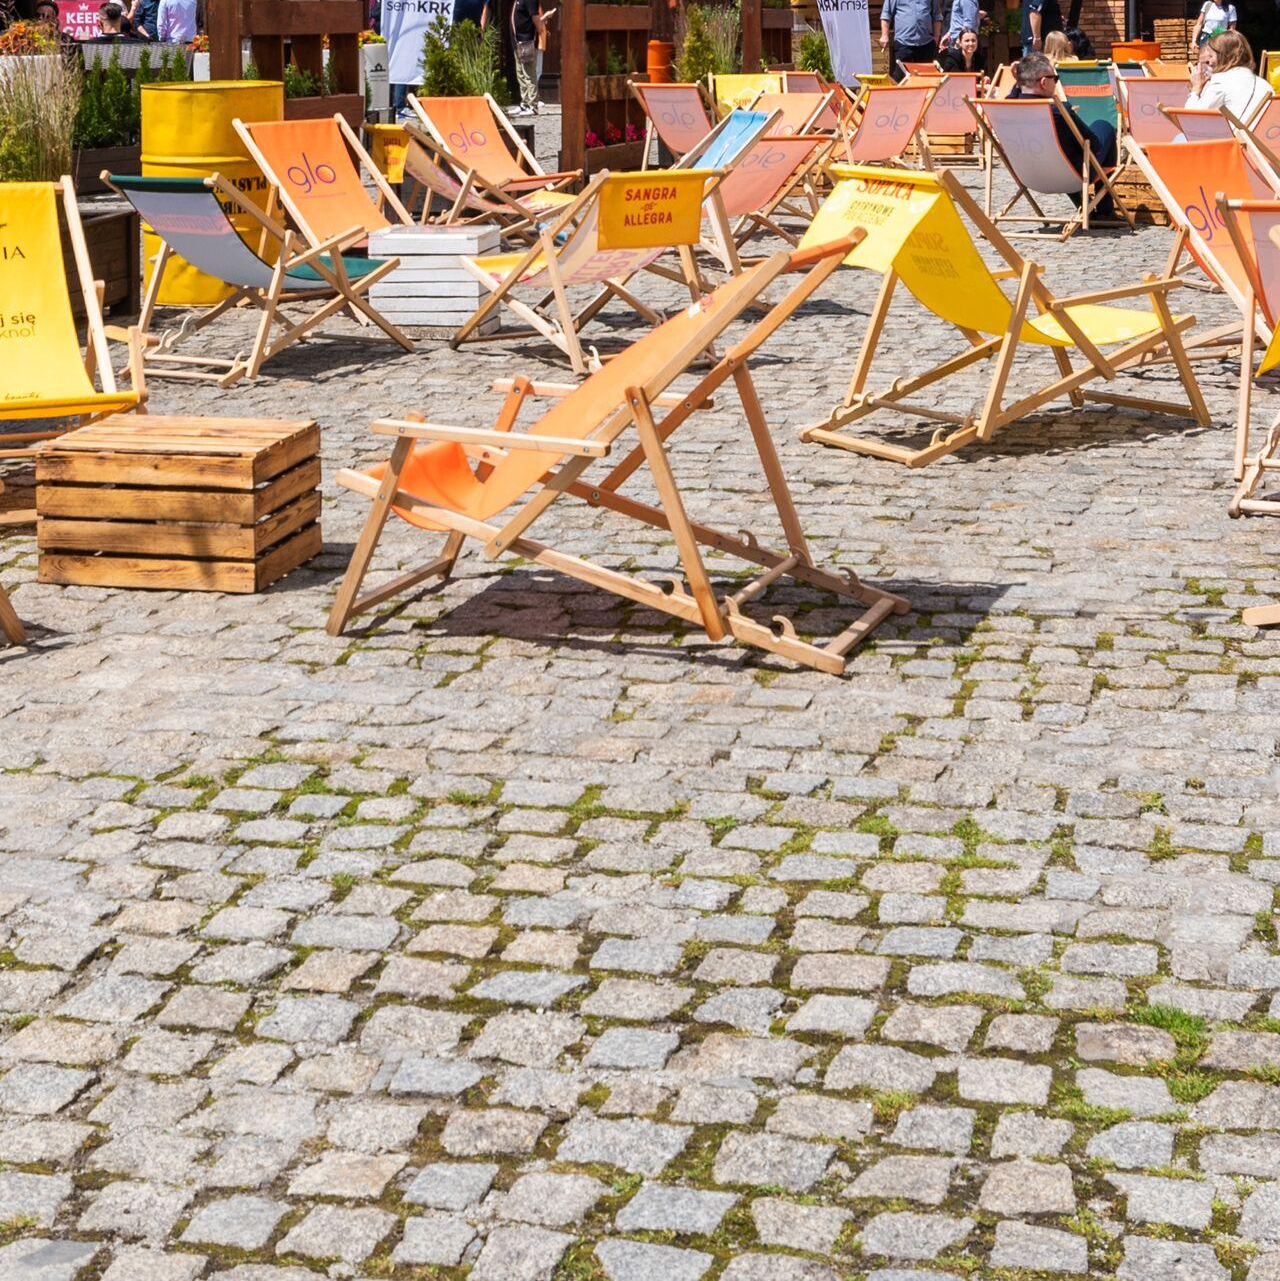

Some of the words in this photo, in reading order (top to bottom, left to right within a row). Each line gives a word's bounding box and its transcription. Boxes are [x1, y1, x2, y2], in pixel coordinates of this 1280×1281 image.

[386, 0, 452, 14] semKRK
[449, 121, 487, 154] glo
[287, 152, 337, 193] glo
[624, 187, 678, 202] SANGRA
[856, 178, 917, 201] SOPLICA
[624, 212, 673, 227] ALLEGRA
[11, 312, 37, 326] się
